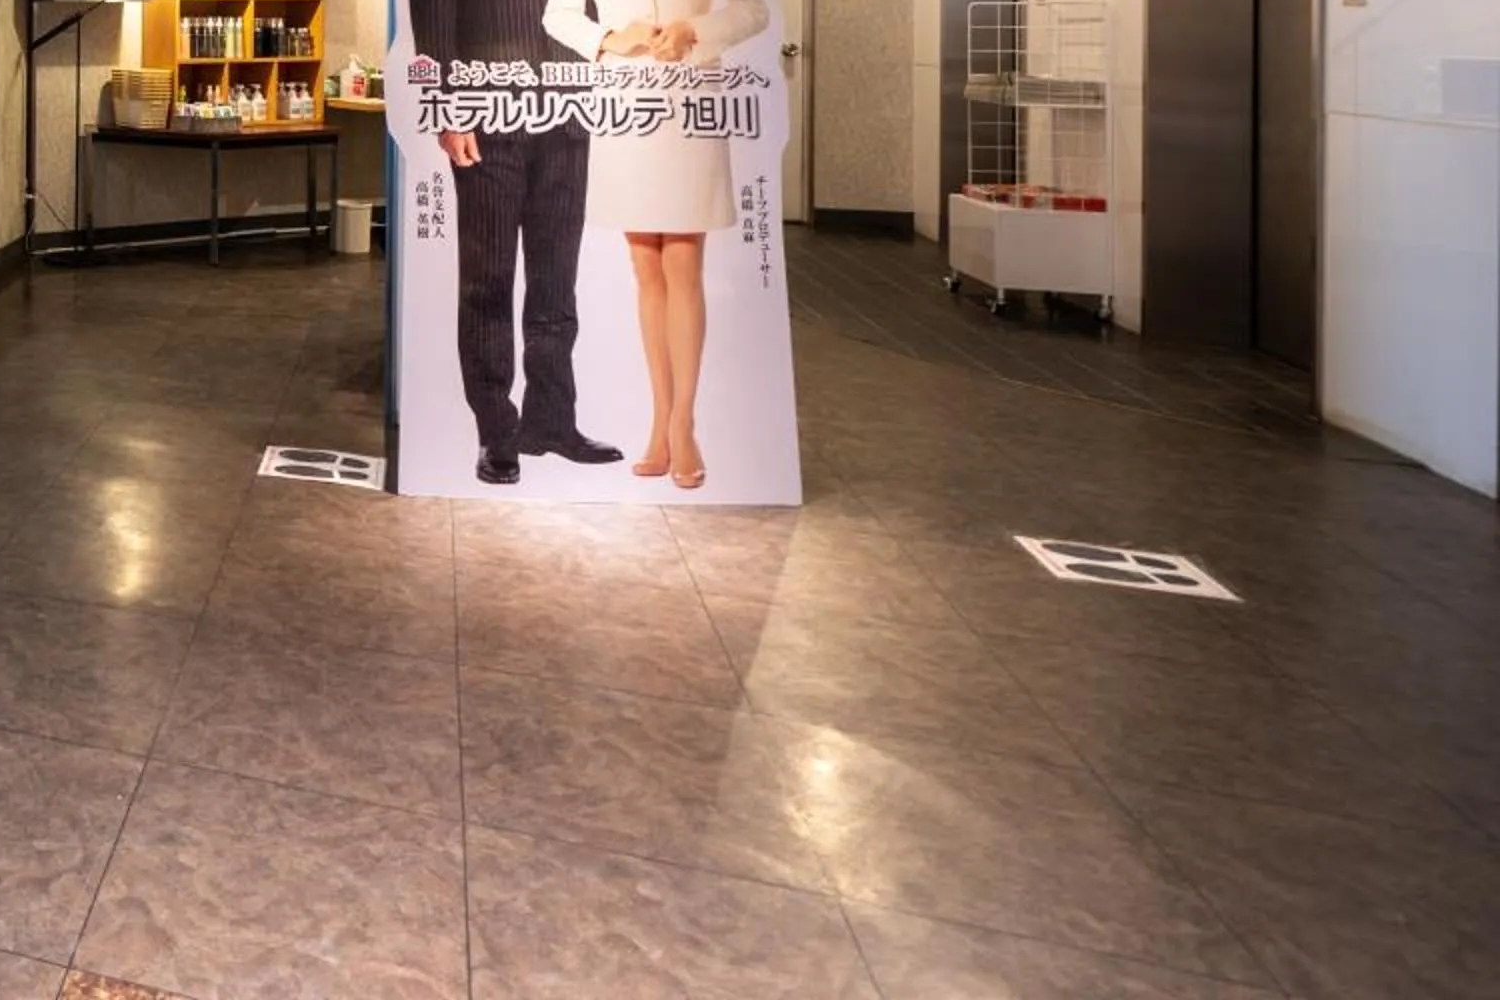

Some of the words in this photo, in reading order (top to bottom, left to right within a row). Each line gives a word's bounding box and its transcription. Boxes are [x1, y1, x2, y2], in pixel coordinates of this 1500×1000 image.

[407, 64, 438, 79] BBH
[418, 94, 668, 131] ホテルリベルテ
[680, 95, 756, 134] 旭川
